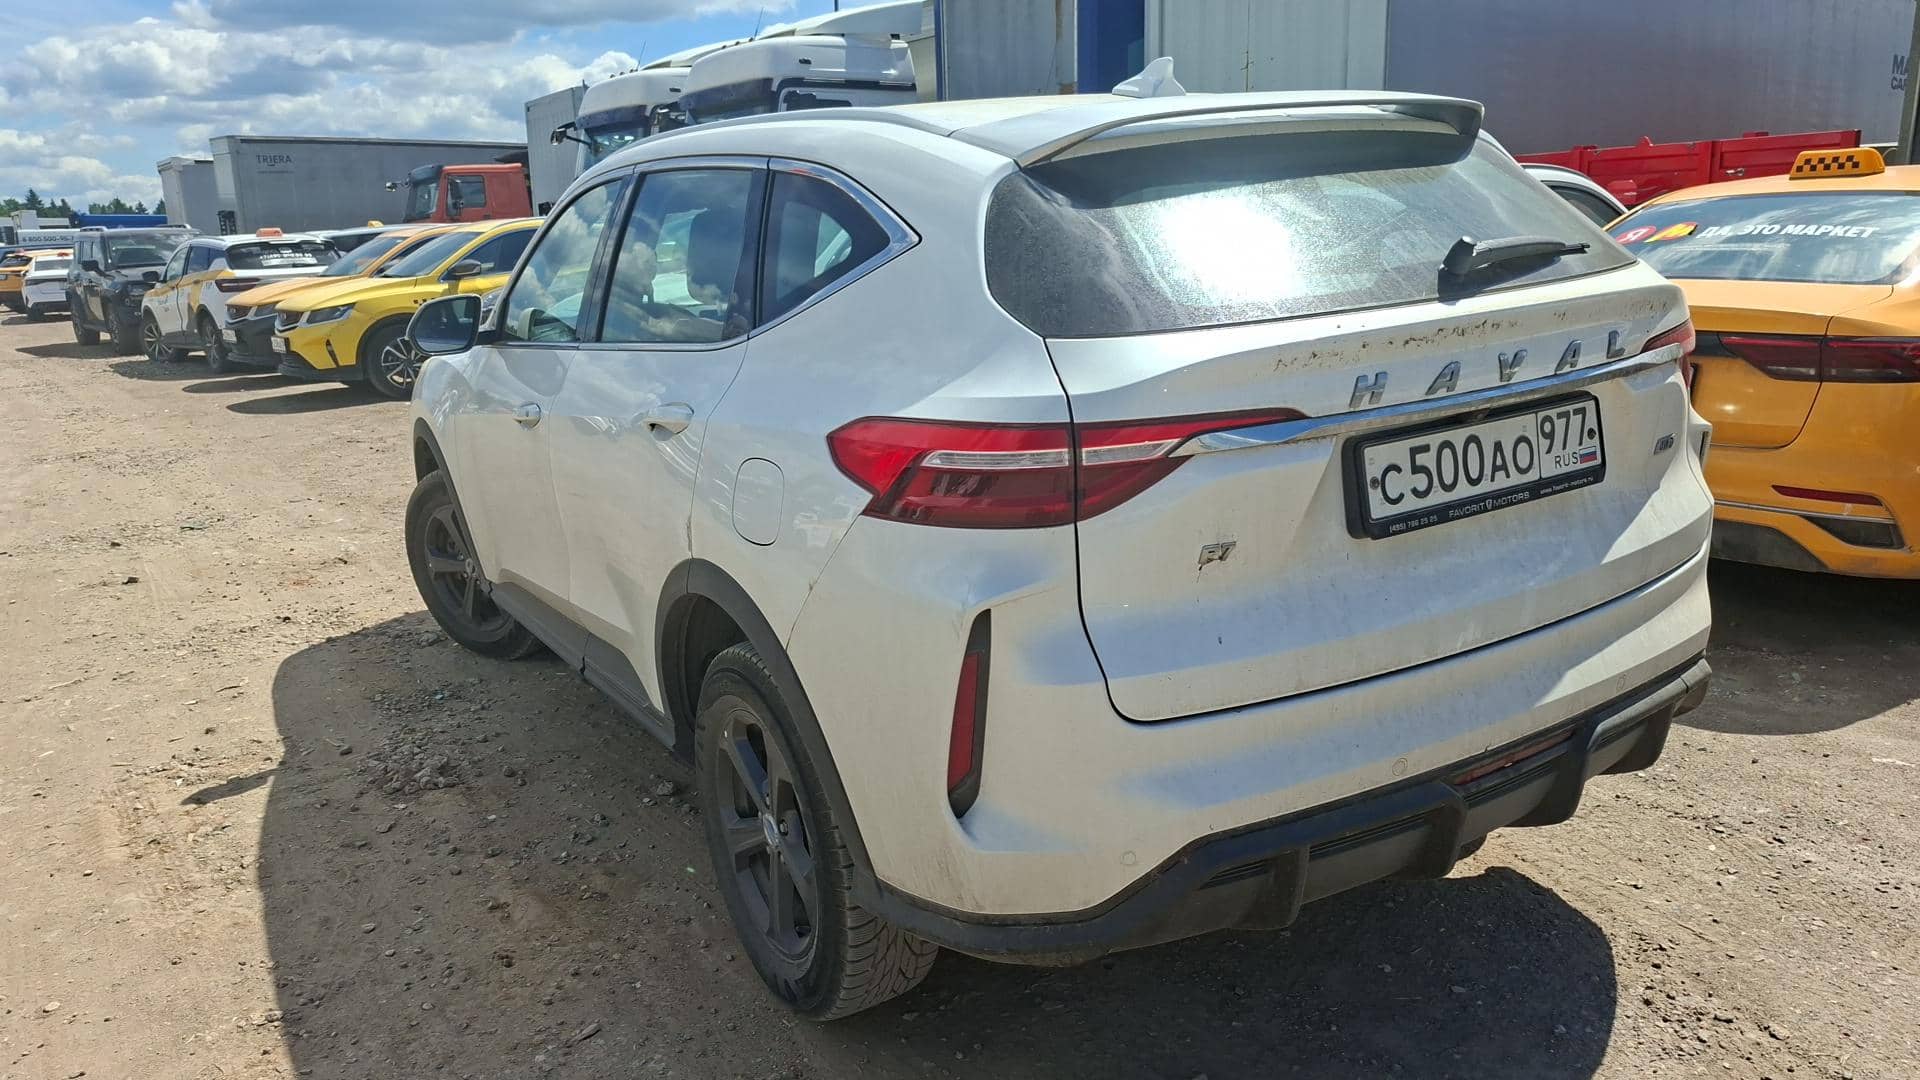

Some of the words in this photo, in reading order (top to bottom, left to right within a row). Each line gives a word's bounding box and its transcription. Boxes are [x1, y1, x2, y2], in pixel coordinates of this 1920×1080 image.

[256, 154, 292, 165] TRIERA
[1739, 224, 1779, 236] ЭТО
[1779, 224, 1880, 239] МАРКЕТ
[1349, 330, 1626, 409] HAVAL
[1539, 406, 1588, 455] 977
[1554, 452, 1579, 470] RUS
[1448, 502, 1485, 518] FAVORIT
[1493, 491, 1530, 507] MOTORS
[1198, 541, 1236, 567] F7
